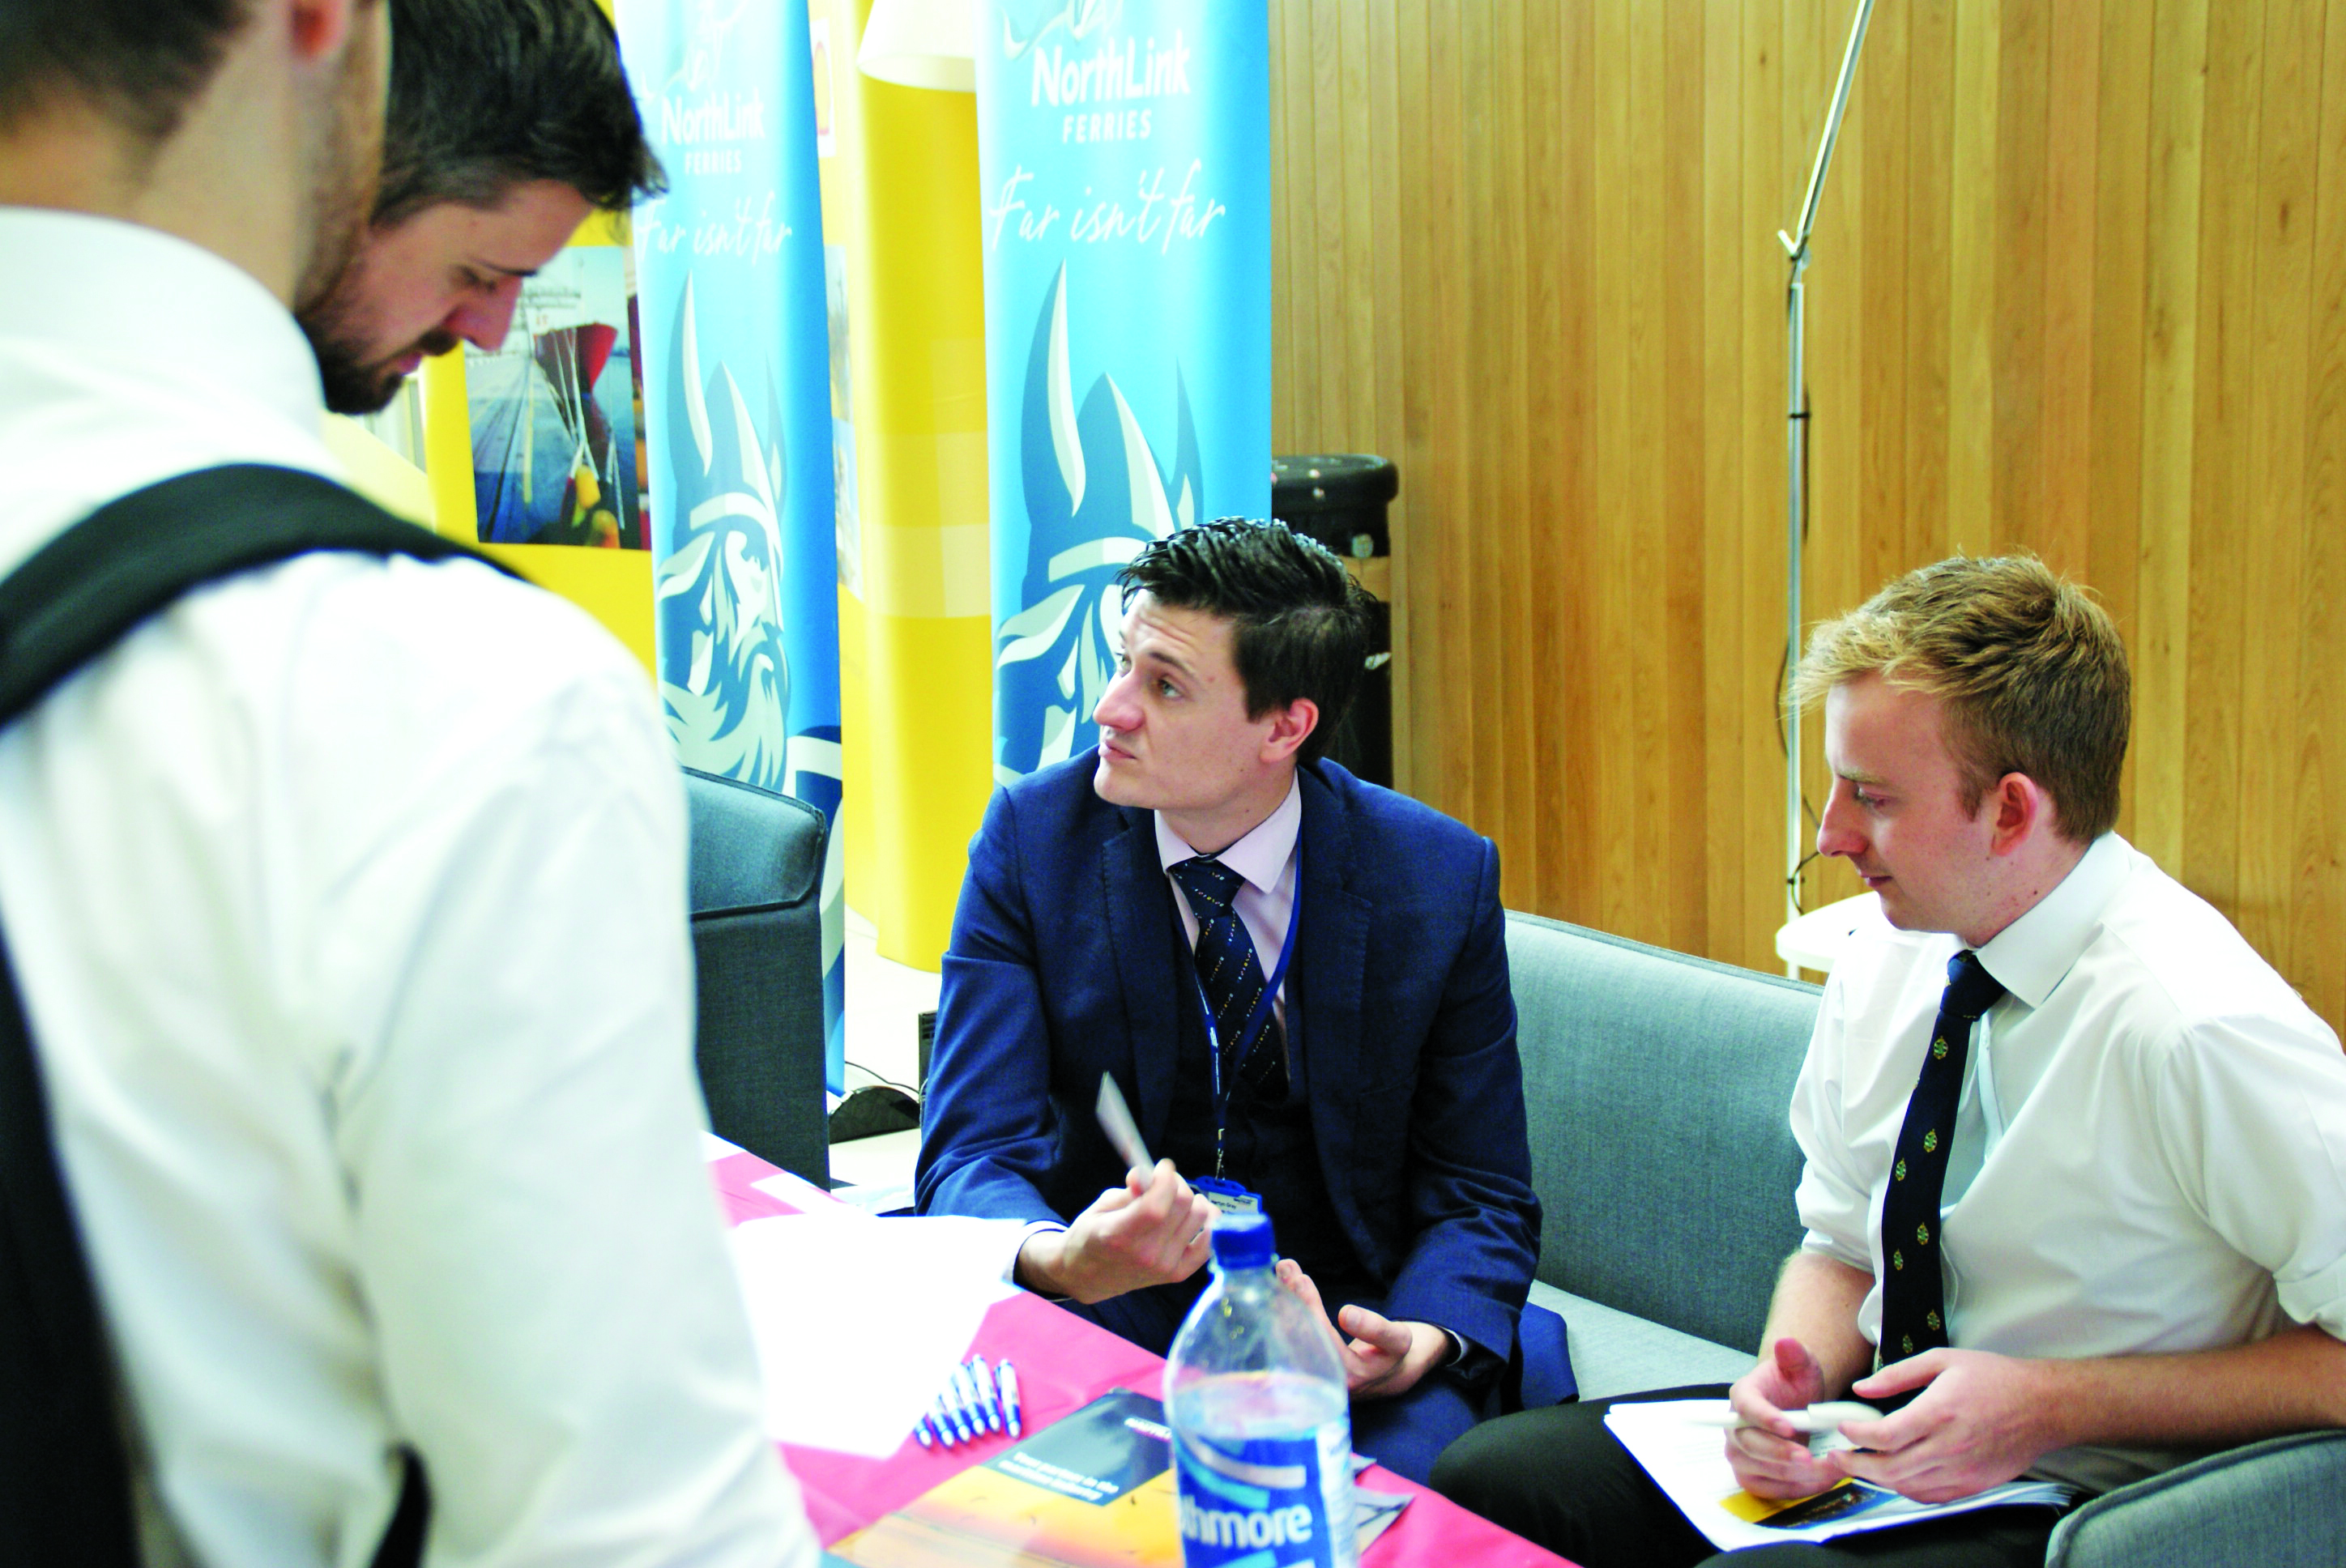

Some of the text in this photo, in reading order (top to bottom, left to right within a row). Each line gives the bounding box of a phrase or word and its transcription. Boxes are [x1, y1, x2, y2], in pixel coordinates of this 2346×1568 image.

[1030, 28, 1192, 107] NorthLink
[661, 86, 766, 146] NorthLink
[1062, 109, 1152, 144] FERRIES
[684, 148, 742, 177] FERRIES
[750, 189, 793, 267] far
[988, 164, 1060, 252] Far
[1161, 157, 1226, 256] far
